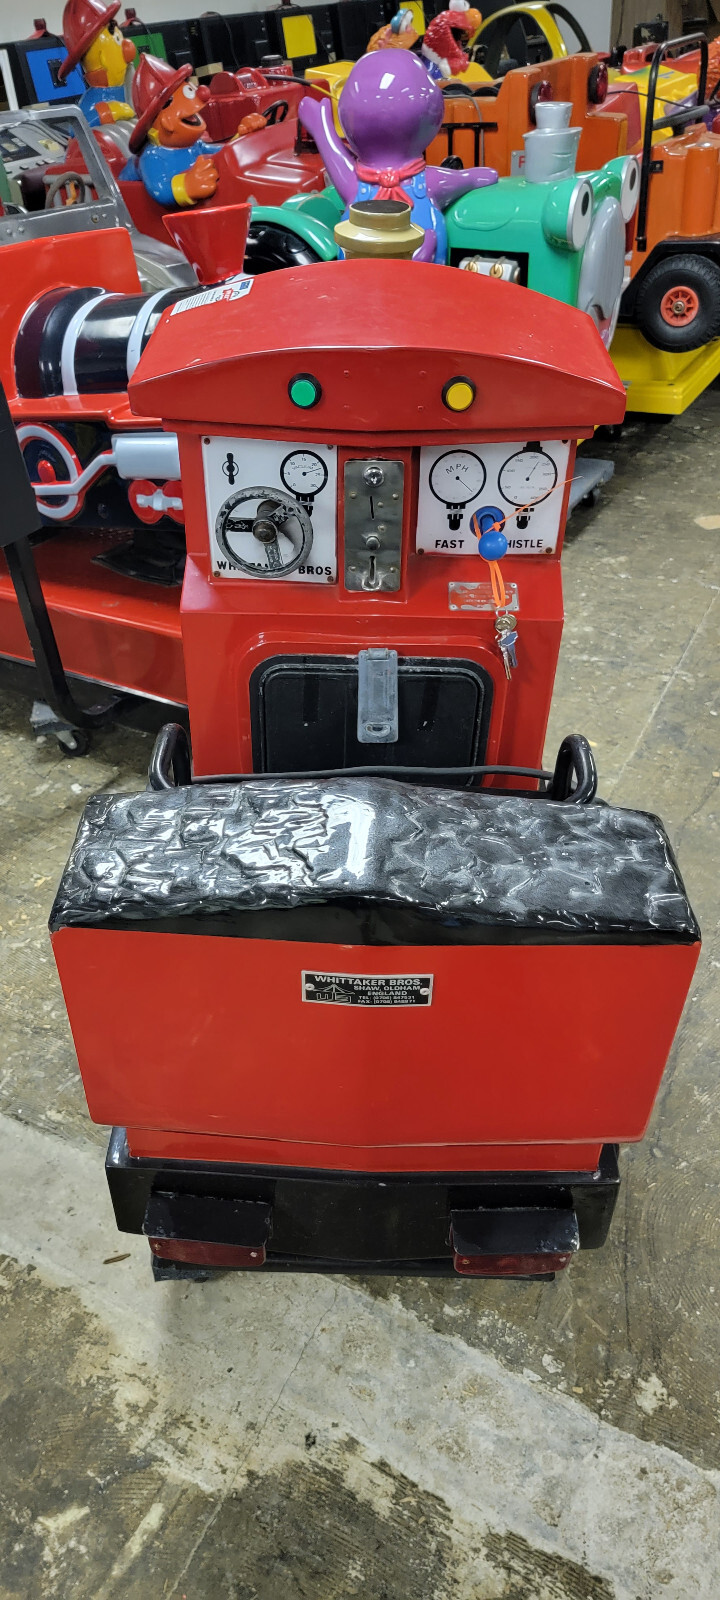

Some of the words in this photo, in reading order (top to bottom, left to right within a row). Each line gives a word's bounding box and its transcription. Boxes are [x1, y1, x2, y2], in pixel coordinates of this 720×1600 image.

[445, 463, 469, 475] MPH
[434, 539, 465, 549] FAST
[507, 539, 544, 549] HISTLE
[298, 565, 332, 576] BROS
[314, 975, 386, 986] WHITTAKER
[389, 978, 423, 986] BROS.
